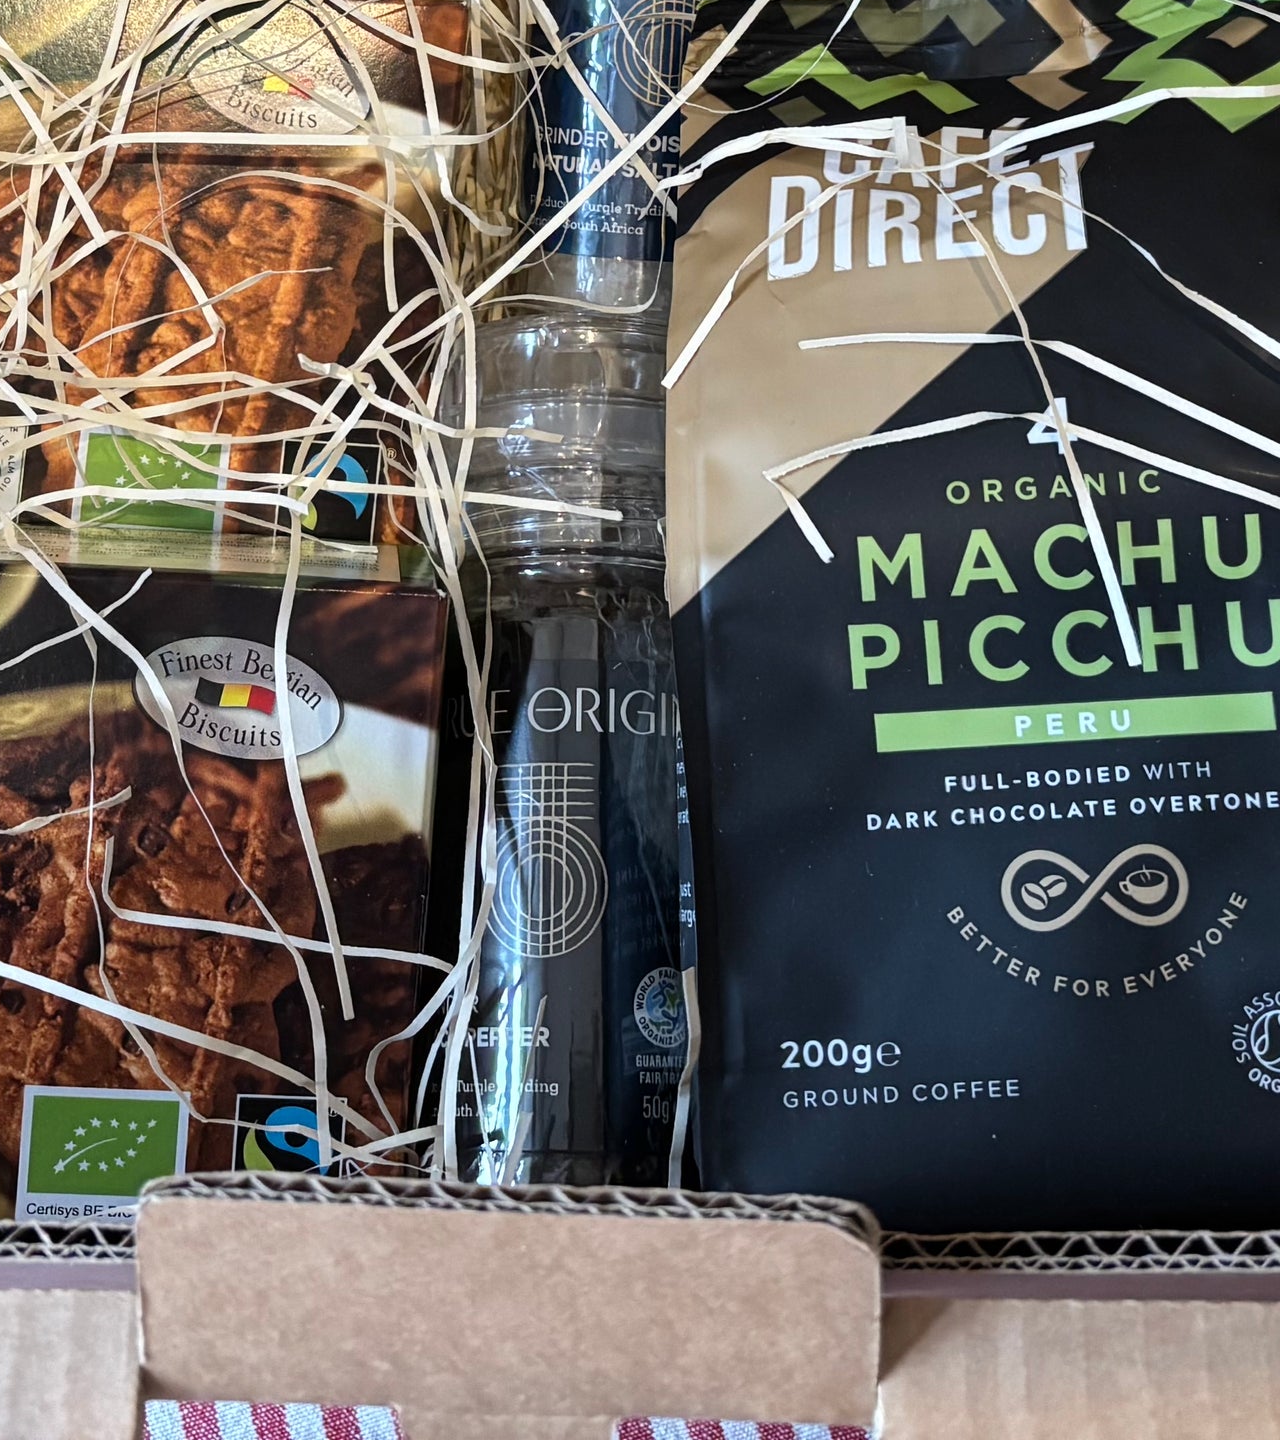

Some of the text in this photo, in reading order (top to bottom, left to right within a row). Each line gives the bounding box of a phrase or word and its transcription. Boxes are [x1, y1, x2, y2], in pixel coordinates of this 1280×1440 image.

[227, 85, 318, 128] Biscuits
[536, 126, 608, 148] GRINDER
[563, 219, 598, 231] South
[601, 222, 644, 235] Africa
[767, 142, 1095, 281] DIRECT
[945, 469, 1161, 505] ORGANIC
[857, 513, 1262, 602] MACHU
[158, 648, 322, 710] Finest Beian
[178, 703, 281, 747] Biscuits
[1014, 709, 1132, 737] PERU
[943, 761, 1212, 793] FULL-BODIED WITH
[866, 812, 939, 831] DARK
[950, 799, 1118, 826] CHOCOLATE
[947, 891, 1248, 998] BETTER FOR EVERYONE
[1232, 1023, 1251, 1063] SOIL
[783, 1080, 1020, 1108] GROUND COFFEE
[26, 1203, 79, 1218] Certisys
